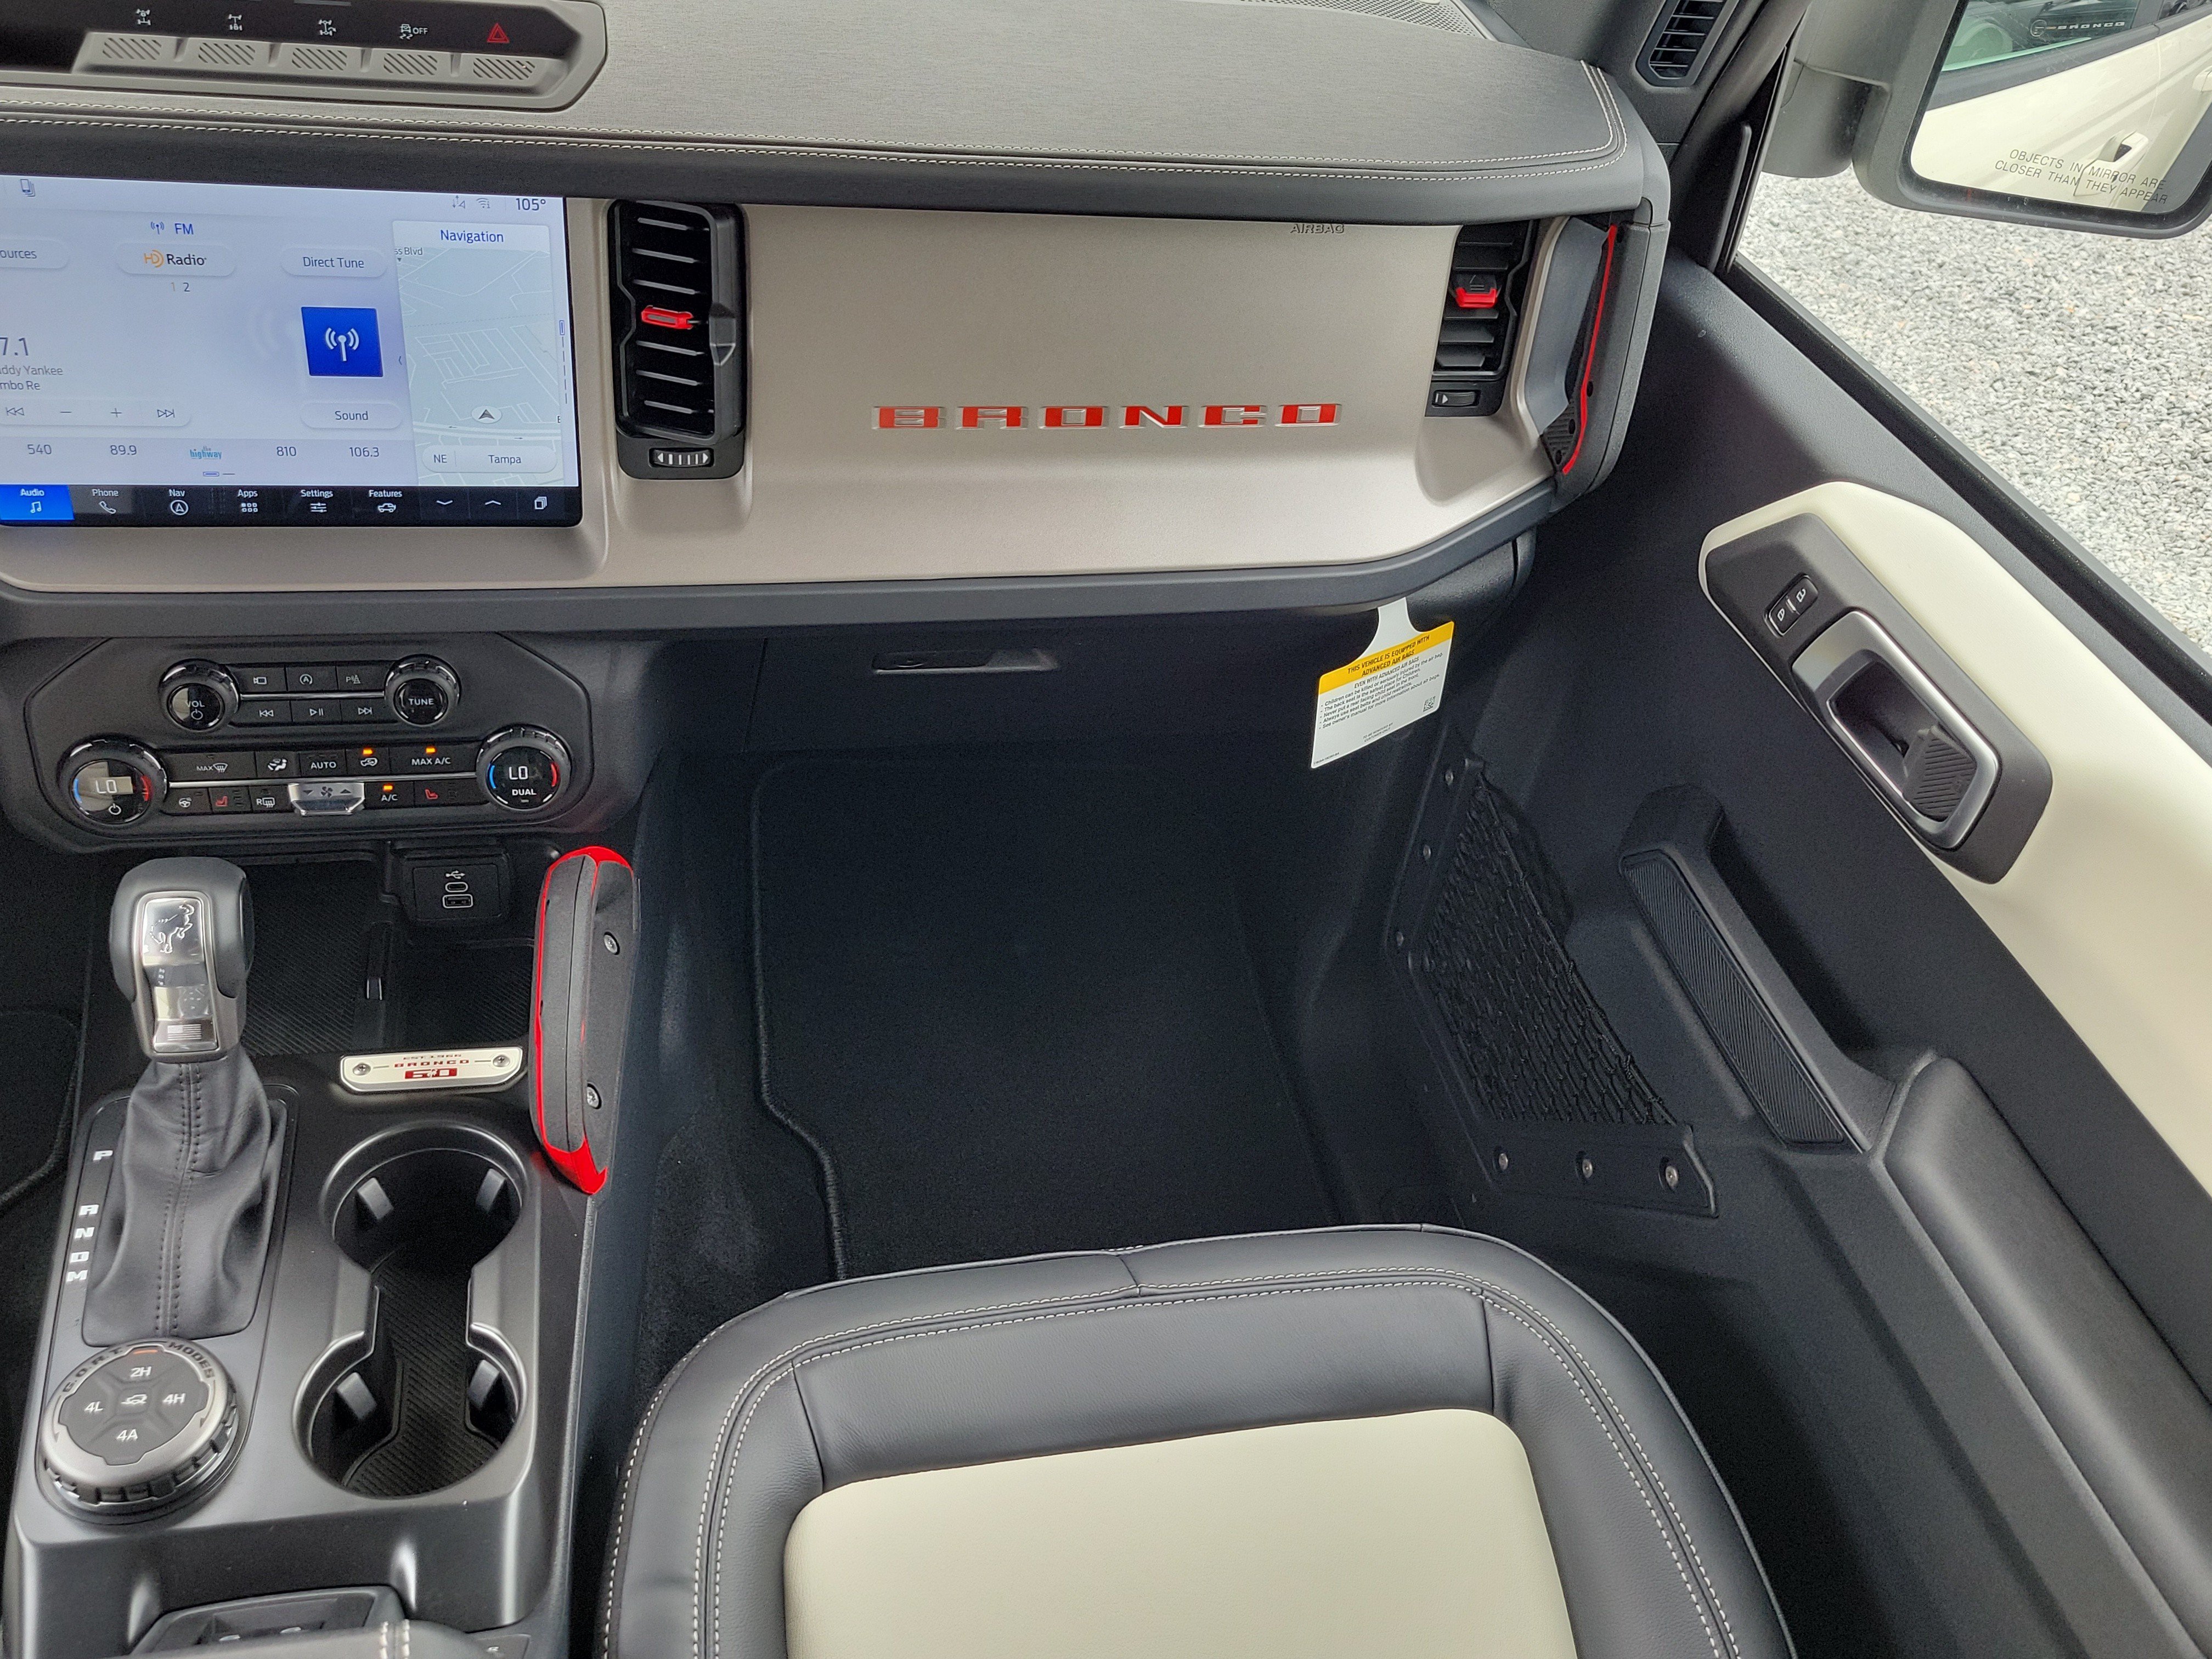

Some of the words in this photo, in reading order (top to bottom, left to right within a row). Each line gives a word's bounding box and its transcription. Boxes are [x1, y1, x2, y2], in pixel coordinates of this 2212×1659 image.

[2058, 21, 2125, 30] BRONCO
[2010, 149, 2064, 168] OBJECTS
[2070, 162, 2084, 173] IN
[2088, 166, 2136, 183] MIRROR
[2141, 176, 2166, 190] ARE
[1995, 160, 2042, 179] CLOSER
[2048, 172, 2080, 187] THAN
[2085, 179, 2117, 194] THEY
[2120, 188, 2168, 205] APPEAR
[516, 198, 546, 211] 105°
[175, 223, 194, 235] FM
[1290, 223, 1344, 233] AIRBAG
[440, 229, 504, 243] Navigation
[404, 247, 422, 255] Blvd
[303, 256, 334, 268] Direct
[337, 257, 364, 268] Tune
[183, 283, 190, 292] 2
[0, 365, 21, 376] ddy
[23, 365, 63, 375] Yankee
[26, 380, 41, 390] Re
[335, 410, 368, 420] Sound
[872, 403, 1340, 429] BRONCO
[27, 445, 52, 455] 540
[110, 445, 137, 455] 89.9
[190, 449, 222, 460] highway
[276, 447, 297, 456] 810
[349, 447, 380, 458] 106.3
[434, 455, 447, 464] NE
[488, 455, 521, 465] Tampa
[92, 489, 119, 497] Phone
[238, 489, 258, 499] Apps
[301, 489, 334, 499] Settings
[1347, 664, 1360, 674] THIS
[1362, 656, 1384, 668] VEHICLE
[1391, 641, 1416, 657] EQUIPPED
[1417, 635, 1430, 646] WITH
[1362, 661, 1390, 676] ADVANCED
[1392, 657, 1401, 665] AIR
[1402, 649, 1415, 661] BAGS
[1354, 680, 1365, 689] EVEN
[1367, 675, 1378, 684] WITH
[1379, 665, 1400, 679] ADVANCED
[1324, 696, 1344, 706] Children
[1361, 684, 1373, 692] killed
[409, 698, 435, 706] TUNE
[1323, 709, 1337, 718] Never
[1360, 695, 1374, 703] facing
[1323, 714, 1340, 723] Always
[311, 760, 337, 769] AUTO
[412, 757, 432, 765] MAX
[509, 766, 528, 780] LO
[95, 779, 117, 794] LO
[512, 788, 537, 796] DUAL
[394, 1059, 469, 1068] BRONCO
[93, 1150, 113, 1161] P
[74, 1227, 94, 1239] N
[70, 1251, 89, 1263] D
[66, 1269, 88, 1283] M
[168, 1342, 215, 1379] MODES
[130, 1366, 152, 1378] 2H
[162, 1393, 185, 1404] 4H
[84, 1401, 103, 1413] 4L
[116, 1429, 138, 1441] 4A
